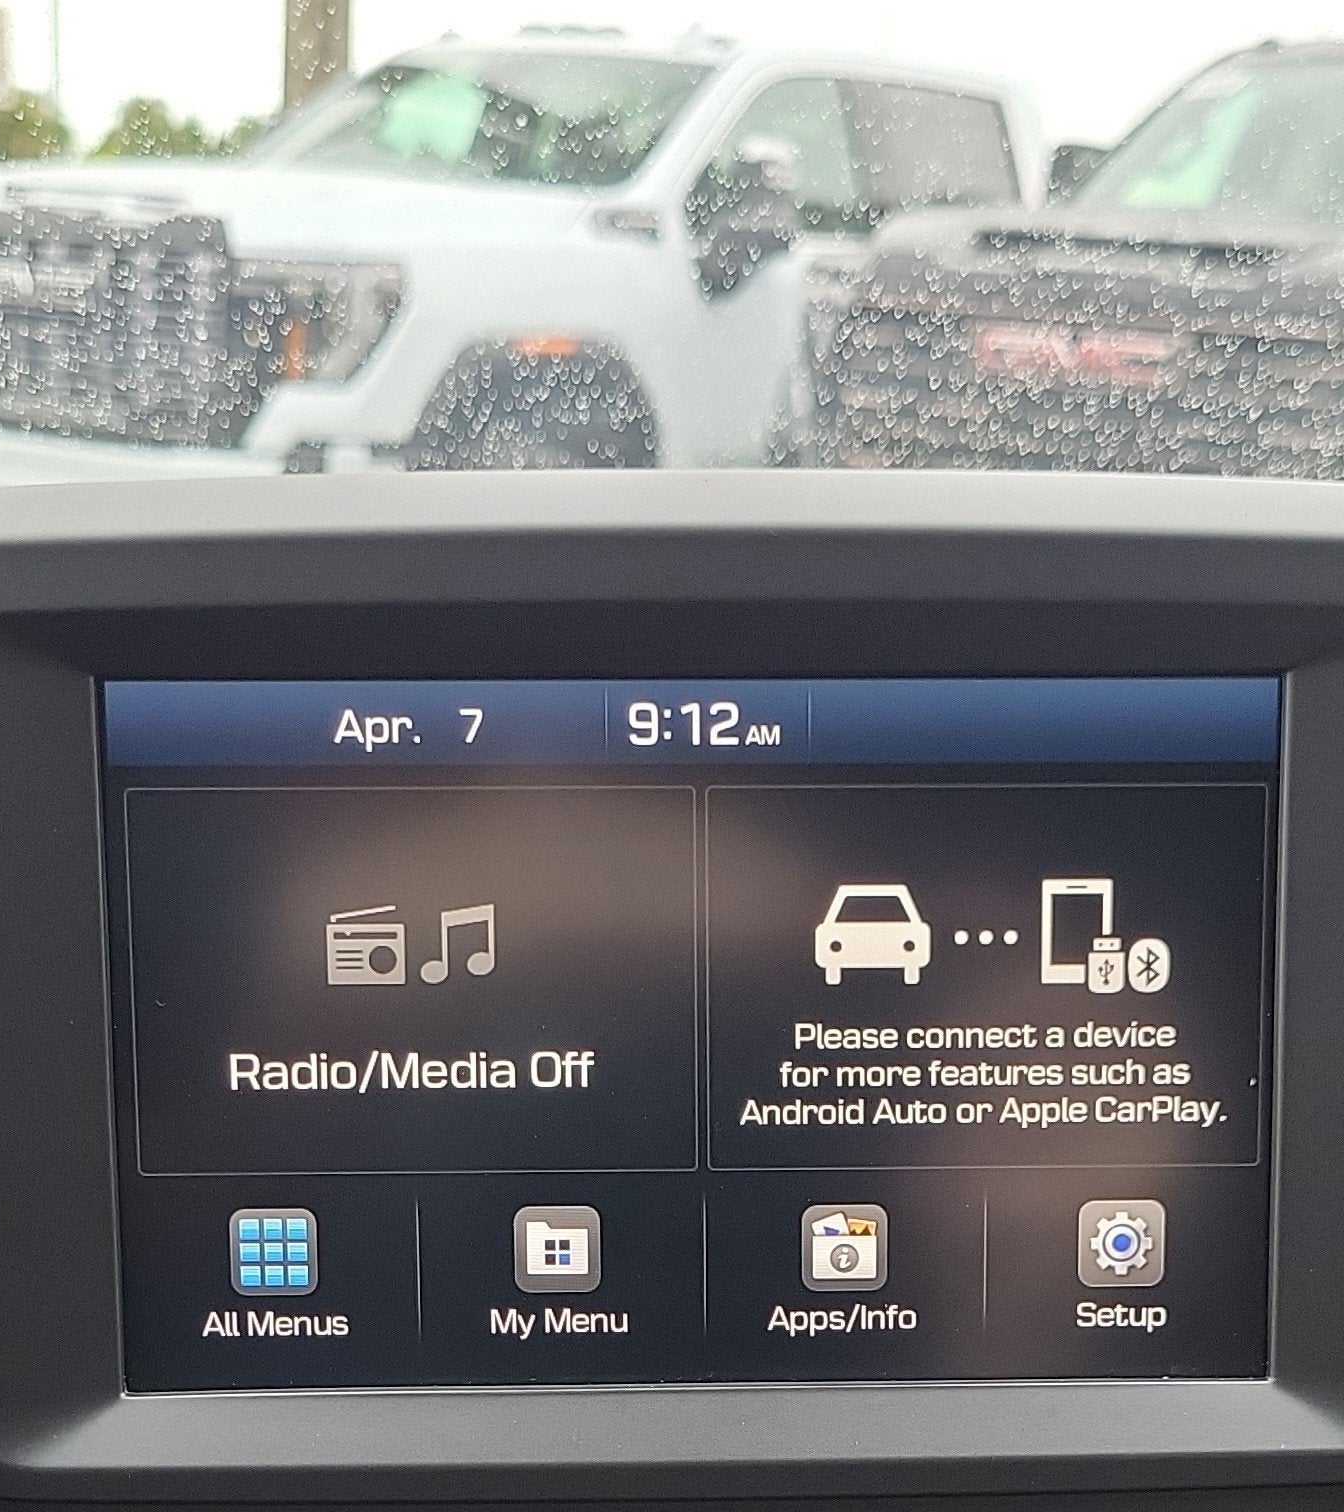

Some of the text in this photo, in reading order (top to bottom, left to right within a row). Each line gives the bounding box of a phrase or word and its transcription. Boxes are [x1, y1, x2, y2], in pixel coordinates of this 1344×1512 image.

[333, 708, 483, 753] Apr. 7
[628, 701, 781, 746] 9:12 AM
[794, 1020, 1176, 1050] Please connect a device
[229, 1050, 595, 1094] Radio/Media Off
[779, 1058, 1191, 1088] for more features such as
[739, 1095, 1227, 1129] Android Auto or Apple CarPlay.
[202, 1310, 349, 1337] All Menus
[490, 1307, 629, 1340] My Menu
[767, 1303, 917, 1337] Apps/Info
[1076, 1301, 1167, 1333] Setup
